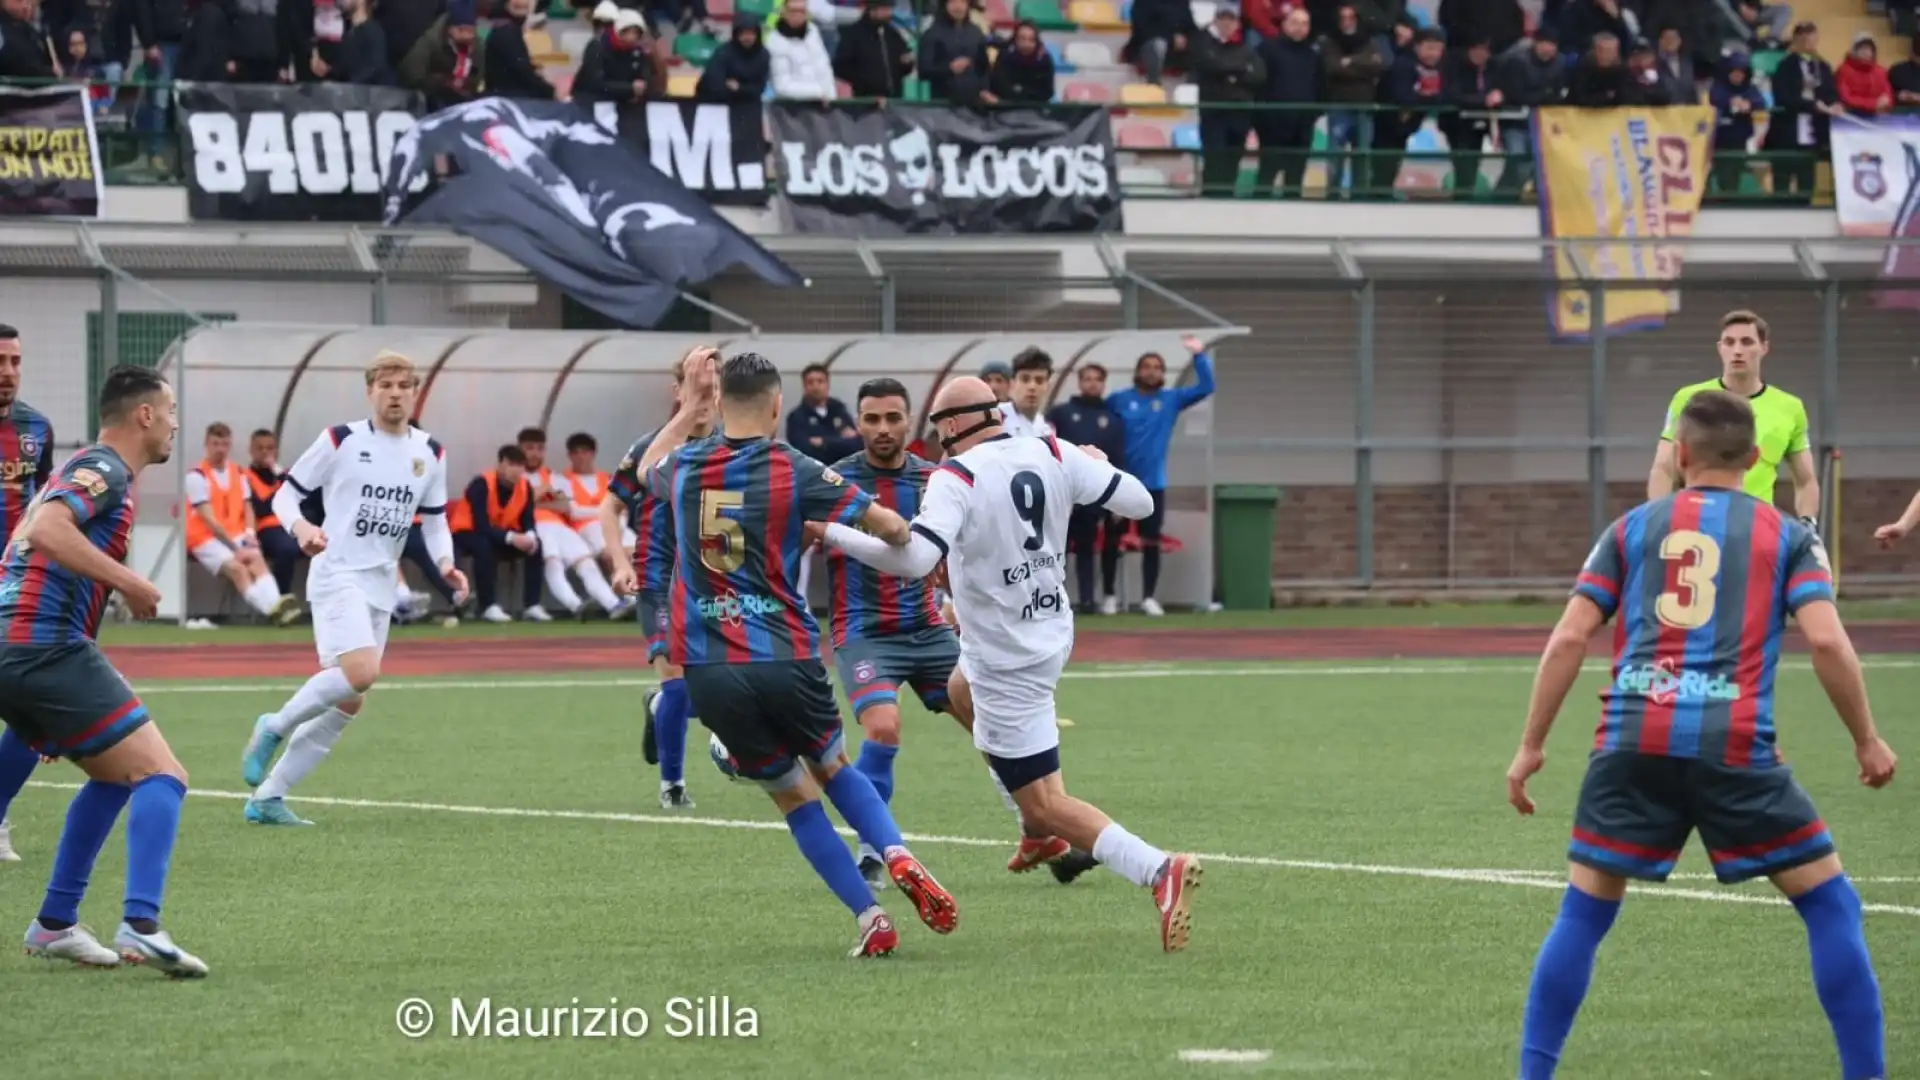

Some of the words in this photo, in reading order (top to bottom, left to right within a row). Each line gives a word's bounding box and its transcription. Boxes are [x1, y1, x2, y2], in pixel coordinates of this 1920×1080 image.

[782, 142, 890, 195] LOS
[938, 144, 1108, 198] LOCOS
[361, 484, 413, 504] north
[700, 488, 745, 573] 5
[1011, 471, 1045, 550] 9
[1655, 529, 1721, 629] 3
